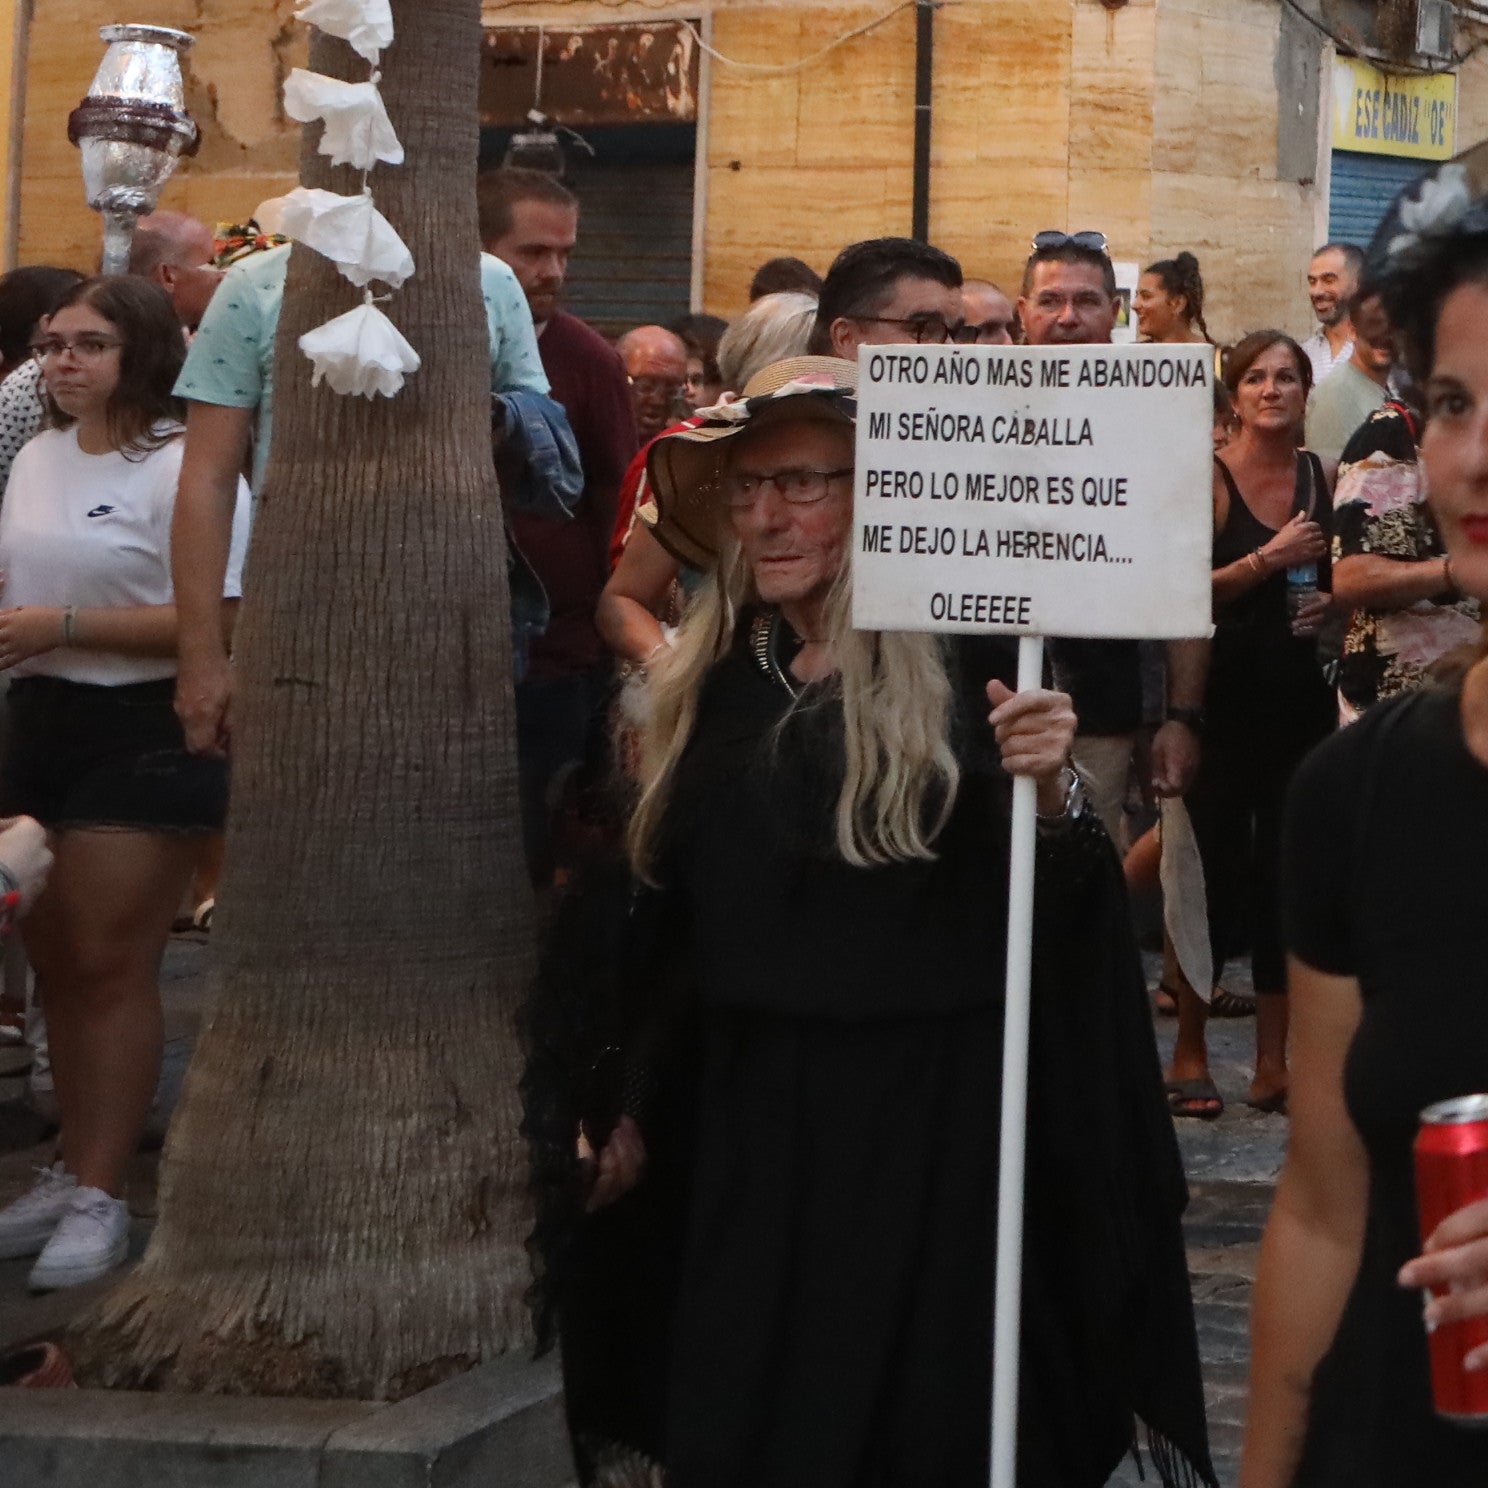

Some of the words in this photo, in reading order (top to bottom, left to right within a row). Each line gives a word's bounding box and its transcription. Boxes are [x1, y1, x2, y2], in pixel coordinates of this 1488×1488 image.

[1355, 88, 1380, 139] ESE
[869, 354, 929, 384] OTRO
[933, 350, 980, 386] AÑO
[986, 357, 1034, 388] MAS
[1040, 359, 1071, 388] ME
[1077, 359, 1208, 388] ABANDONA
[868, 412, 891, 440] MI
[897, 407, 986, 443] SEÑORA
[992, 415, 1094, 446] CABALLA
[866, 469, 923, 499] PERO
[930, 472, 959, 501] LO
[965, 473, 1040, 504] MEJOR
[1046, 476, 1074, 506] ES
[1081, 477, 1129, 507] QUE
[862, 524, 893, 553] ME
[899, 526, 956, 556] DEJO
[963, 528, 990, 557] LA
[996, 530, 1133, 564] HERENCIA....
[930, 592, 1033, 625] OLEEEEE
